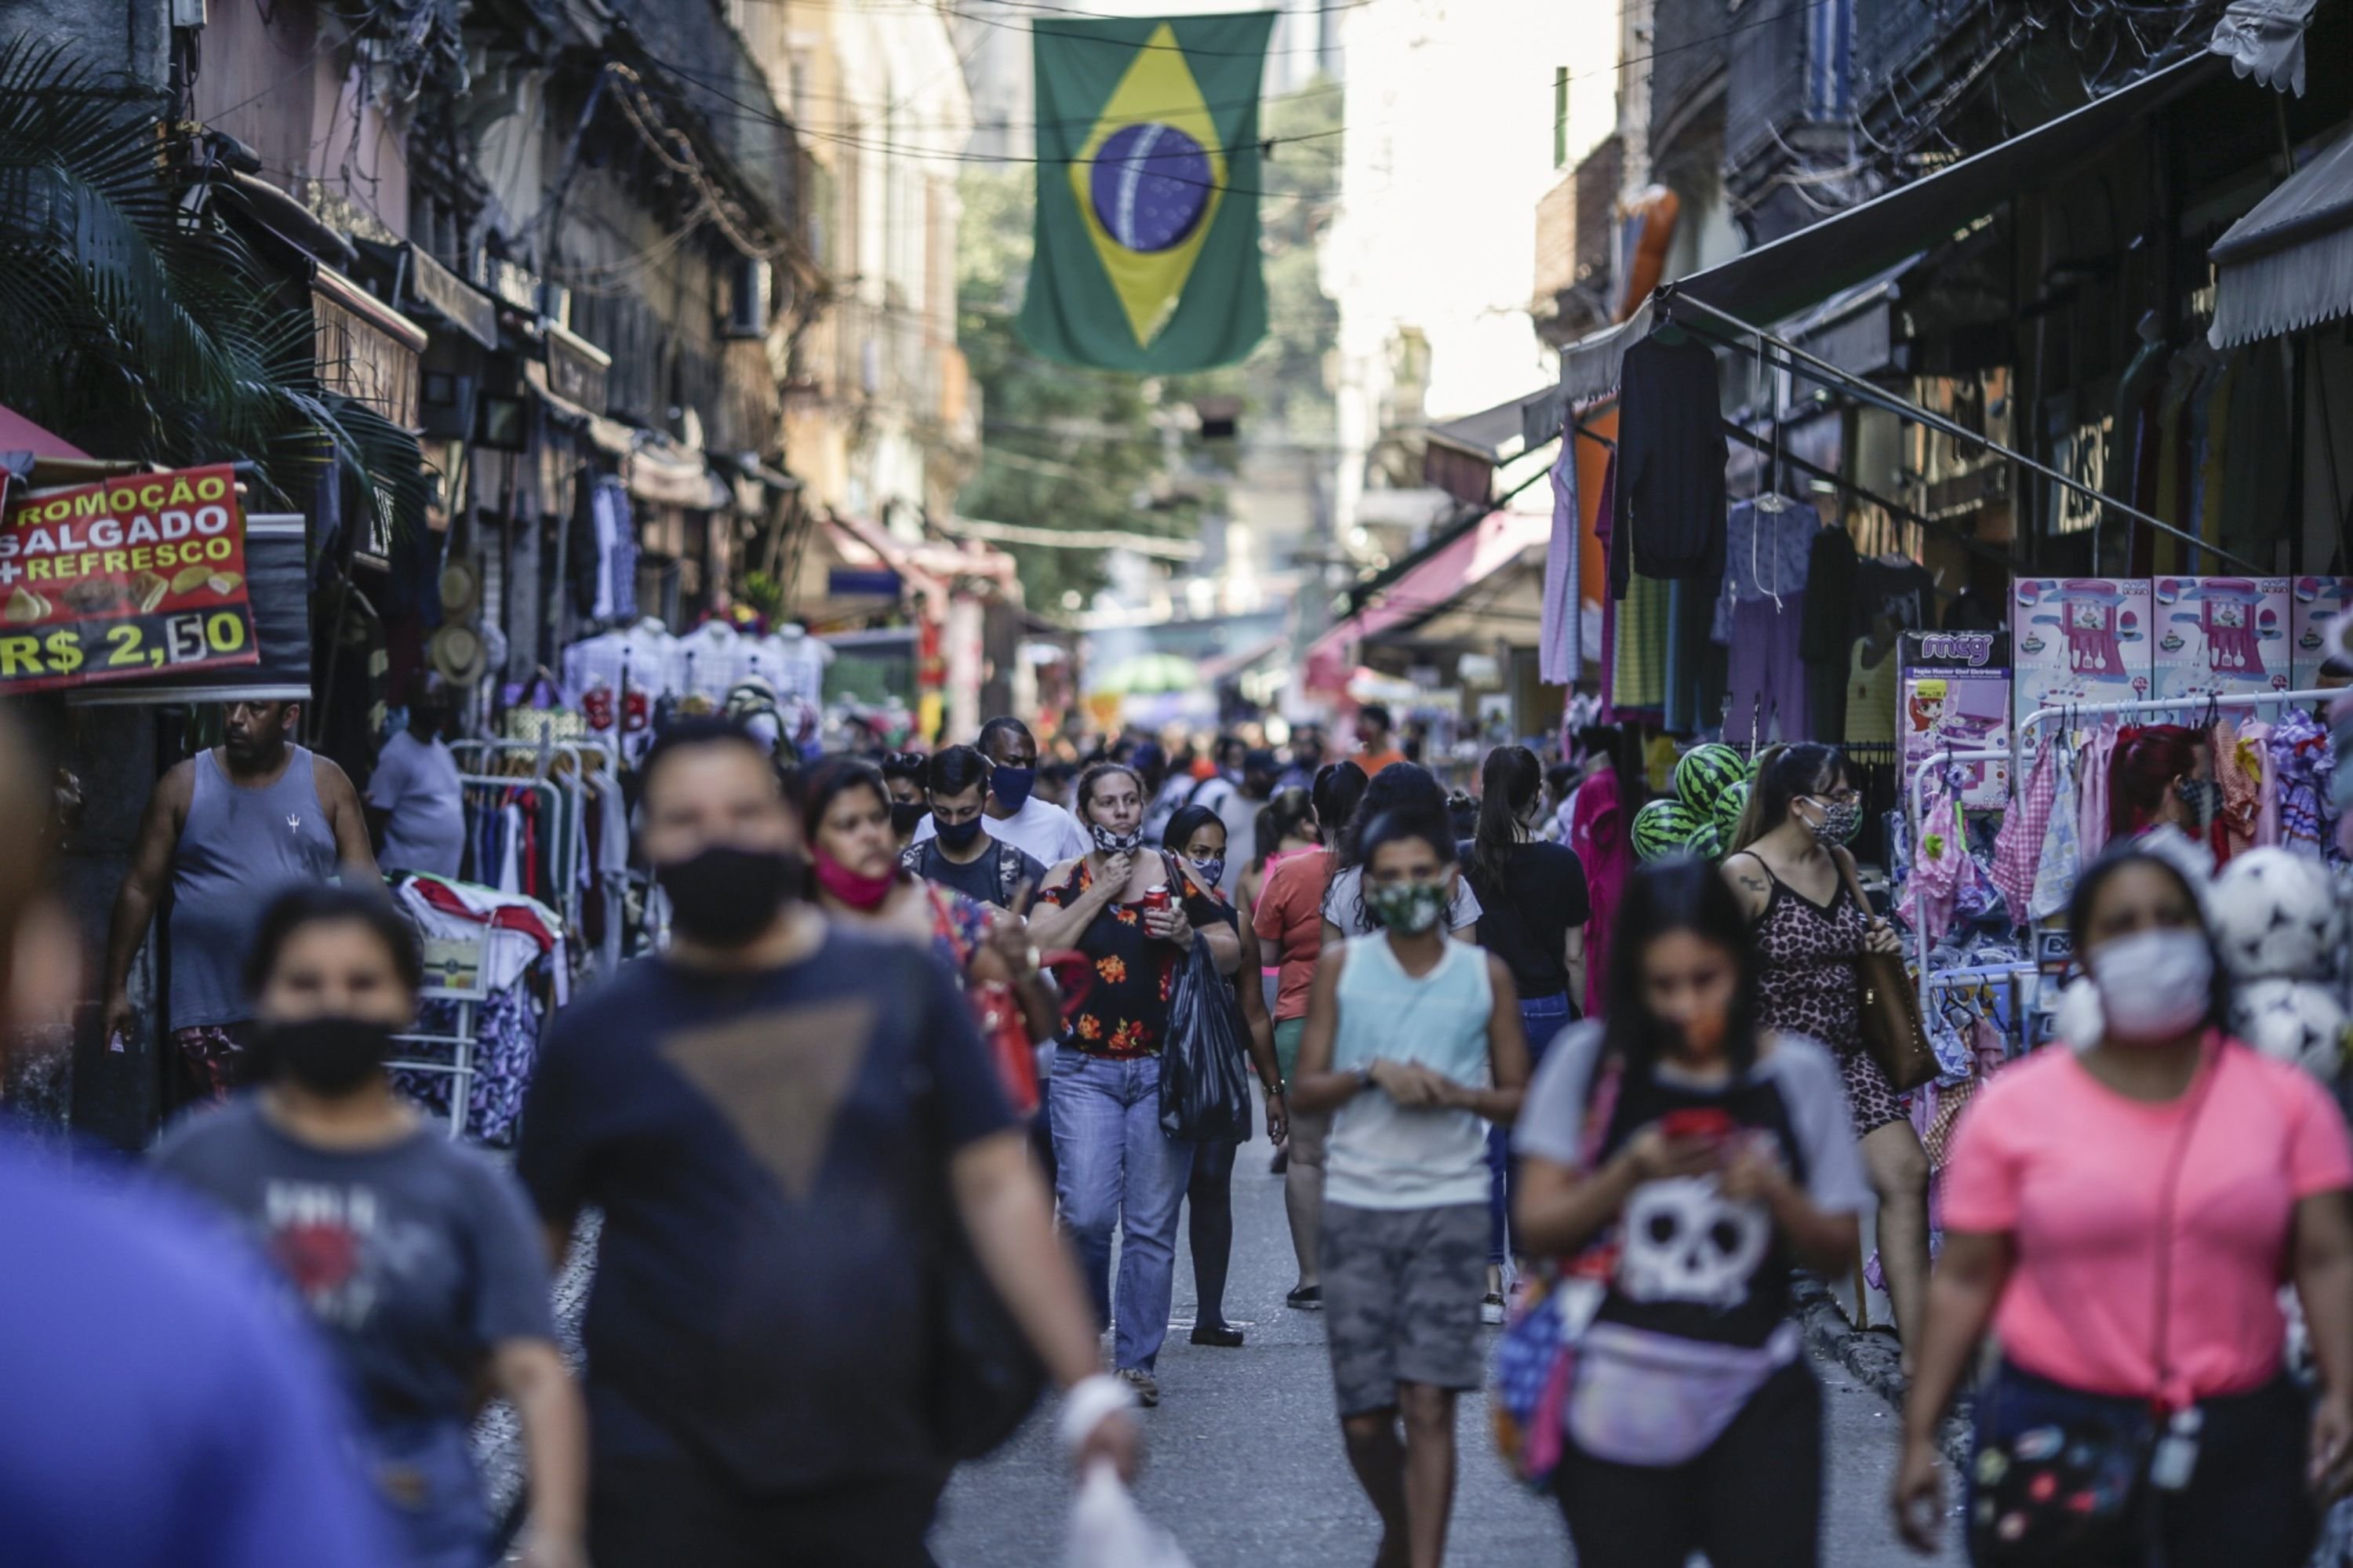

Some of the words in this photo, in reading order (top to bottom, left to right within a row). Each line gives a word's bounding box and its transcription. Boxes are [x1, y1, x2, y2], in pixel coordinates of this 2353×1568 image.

[17, 477, 226, 526] ROMOÇÃO
[0, 506, 228, 558] SALGADO
[0, 630, 83, 675] R$
[107, 612, 244, 668] 2,50
